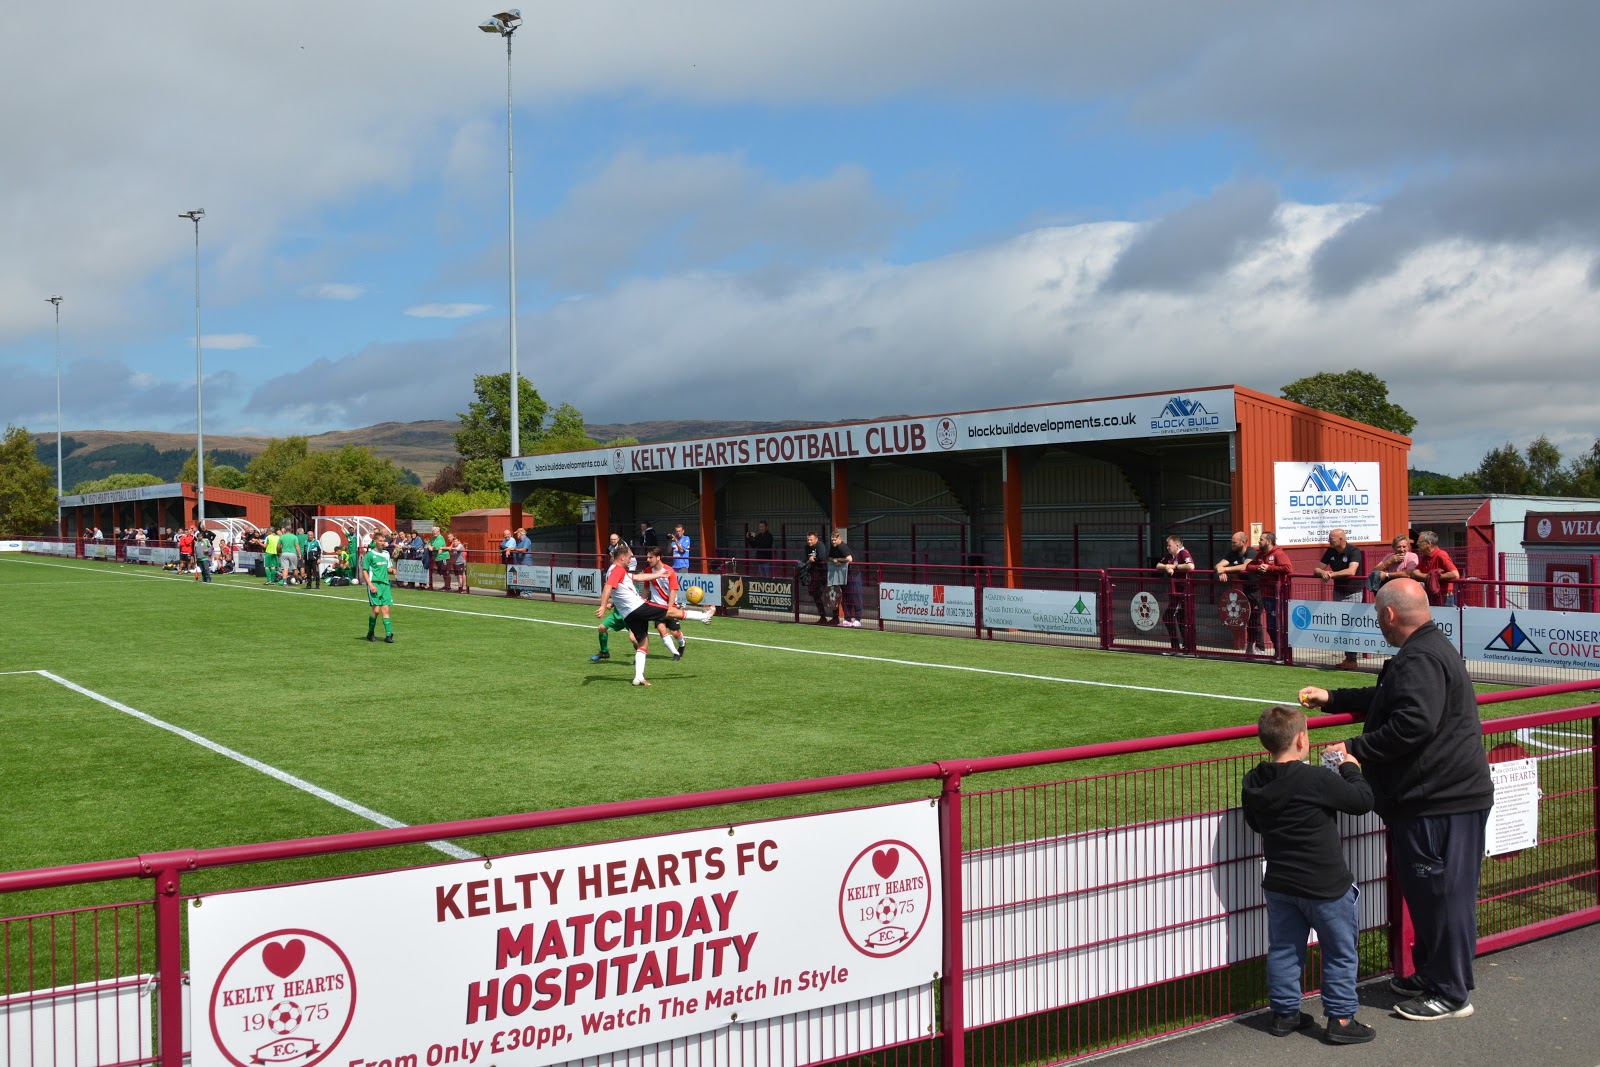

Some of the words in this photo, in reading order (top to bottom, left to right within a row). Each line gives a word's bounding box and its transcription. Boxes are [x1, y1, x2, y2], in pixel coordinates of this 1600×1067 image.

[968, 412, 1137, 438] blockbuilddevelopments.co.uk
[1151, 418, 1185, 429] BLOCK
[1188, 416, 1219, 426] BUILD
[631, 446, 677, 472] KELTY
[682, 440, 750, 468] HEARTS
[755, 430, 860, 462] FOOTBALL
[865, 423, 927, 455] CLUB
[1289, 495, 1332, 507] BLOCK
[1335, 494, 1369, 506] BUILD
[748, 581, 792, 594] KINGDOM
[749, 595, 770, 605] FANCY
[770, 596, 792, 607] DRESS
[880, 588, 895, 600] DC
[895, 589, 930, 606] Lighting
[987, 593, 1006, 601] GARDEN
[1007, 594, 1023, 602] ROOMS
[896, 602, 928, 616] Services
[930, 605, 945, 618] Ltd
[1033, 612, 1092, 626] GARDEN2ROOM
[1341, 613, 1381, 629] Brothe
[1312, 633, 1330, 643] You
[1333, 636, 1360, 646] stand
[1364, 639, 1376, 647] on
[1380, 640, 1392, 648] ou
[1529, 628, 1546, 638] THE
[1549, 628, 1600, 643] CONSER
[1483, 653, 1510, 661] Scotland's
[1511, 655, 1533, 664] Leading
[1534, 657, 1571, 667] Conservatory
[1572, 660, 1586, 668] Roof
[1492, 774, 1508, 785] ELTY
[1510, 770, 1536, 782] HEARTS
[435, 868, 565, 923] KELTY
[577, 846, 726, 901] HEARTS
[736, 839, 779, 876] FC
[847, 883, 881, 901] KELTY
[885, 876, 924, 895] HEARTS
[859, 906, 874, 922] 19
[898, 899, 915, 915] 75
[495, 889, 739, 970] MATCHDAY
[466, 931, 759, 1025] HOSPITALITY
[222, 984, 275, 1007] KELTY
[283, 973, 345, 998] HEARTS
[242, 1013, 266, 1032] 19
[304, 1002, 330, 1022] 75
[426, 1037, 484, 1064] Only
[490, 1024, 573, 1055] £30pp,
[581, 1003, 651, 1036] Watch
[658, 996, 698, 1020] The
[705, 980, 767, 1011] Match
[773, 976, 792, 997] In
[797, 965, 849, 992] Style
